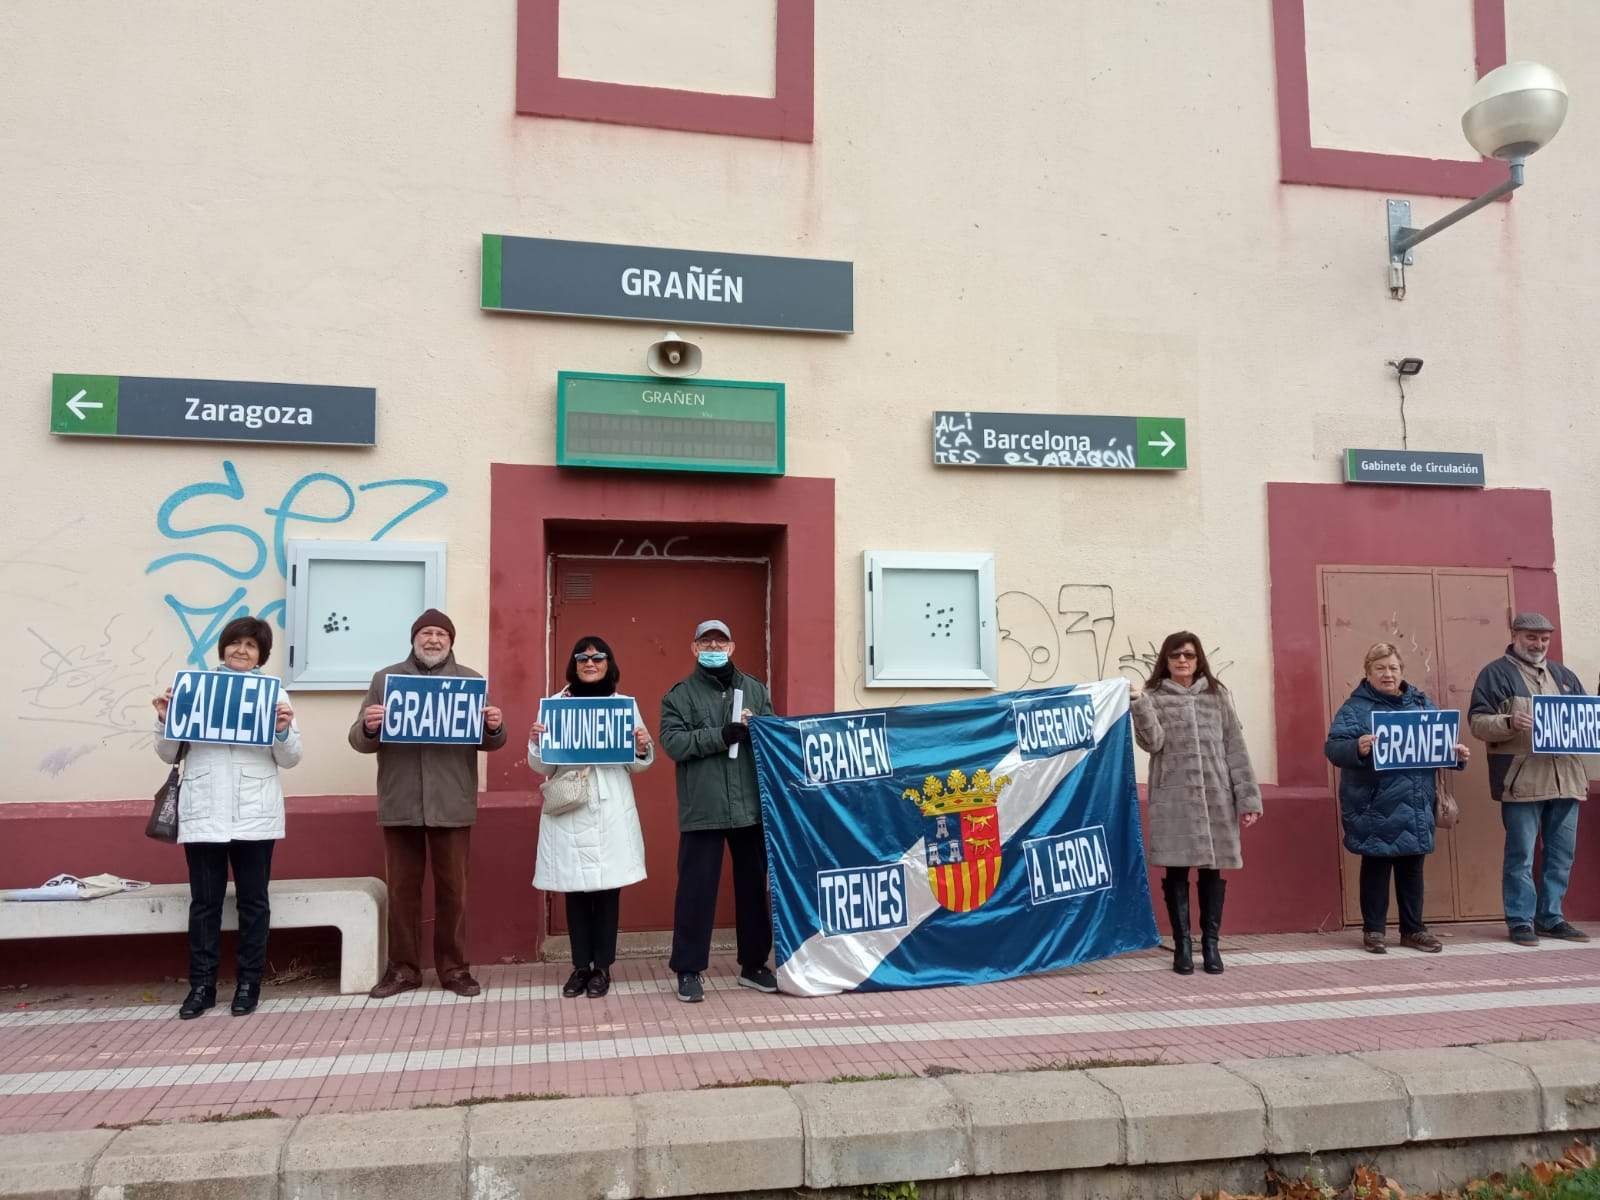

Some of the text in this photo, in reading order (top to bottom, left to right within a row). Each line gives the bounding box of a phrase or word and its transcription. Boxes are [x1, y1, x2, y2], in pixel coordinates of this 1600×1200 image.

[621, 265, 744, 304] GRAÑÉN
[184, 397, 313, 429] Zaragoza
[641, 390, 705, 406] GRAÑEN
[983, 429, 1091, 451] Barcelona
[1361, 460, 1479, 474] Gabinete de Circulación
[170, 672, 276, 743] CALLEN
[385, 681, 482, 738] GRAÑÉN
[541, 707, 633, 750] ALMUNIENTE
[1017, 704, 1094, 753] QUEREMOS
[805, 717, 889, 783] GRAÑÉN
[1375, 713, 1456, 764] GRAÑÉN
[1031, 834, 1109, 898] A LERIDA
[820, 868, 903, 932] TRENES
